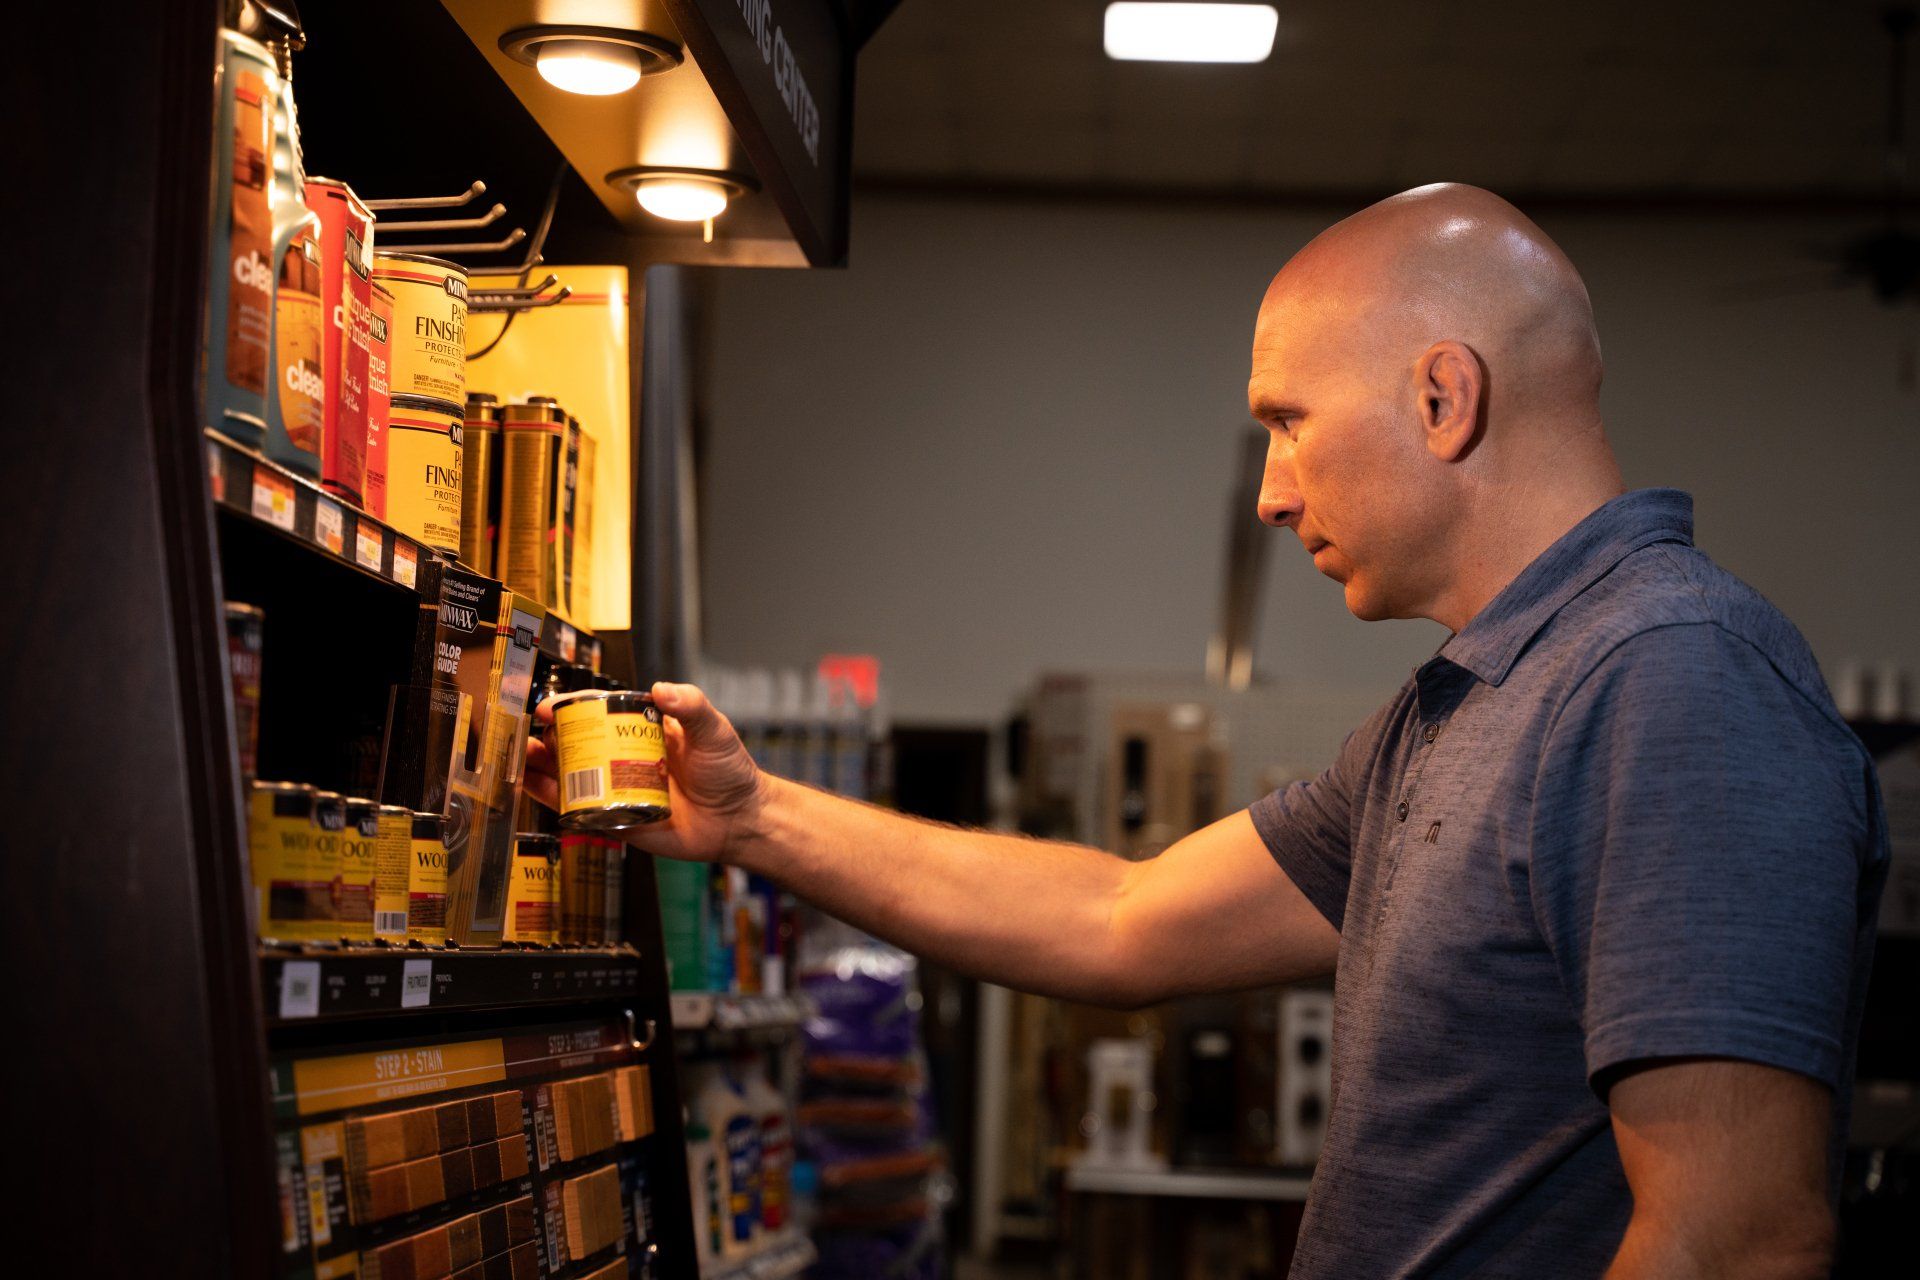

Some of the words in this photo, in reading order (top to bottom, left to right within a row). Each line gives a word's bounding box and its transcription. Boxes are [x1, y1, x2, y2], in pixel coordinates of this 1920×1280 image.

[774, 24, 819, 168] CENTER
[438, 640, 461, 661] COLOR
[437, 660, 459, 675] GUIDE
[417, 851, 447, 868] WOO
[376, 1054, 400, 1079] STEP
[403, 1052, 410, 1075] 2
[416, 1048, 443, 1073] STAIN
